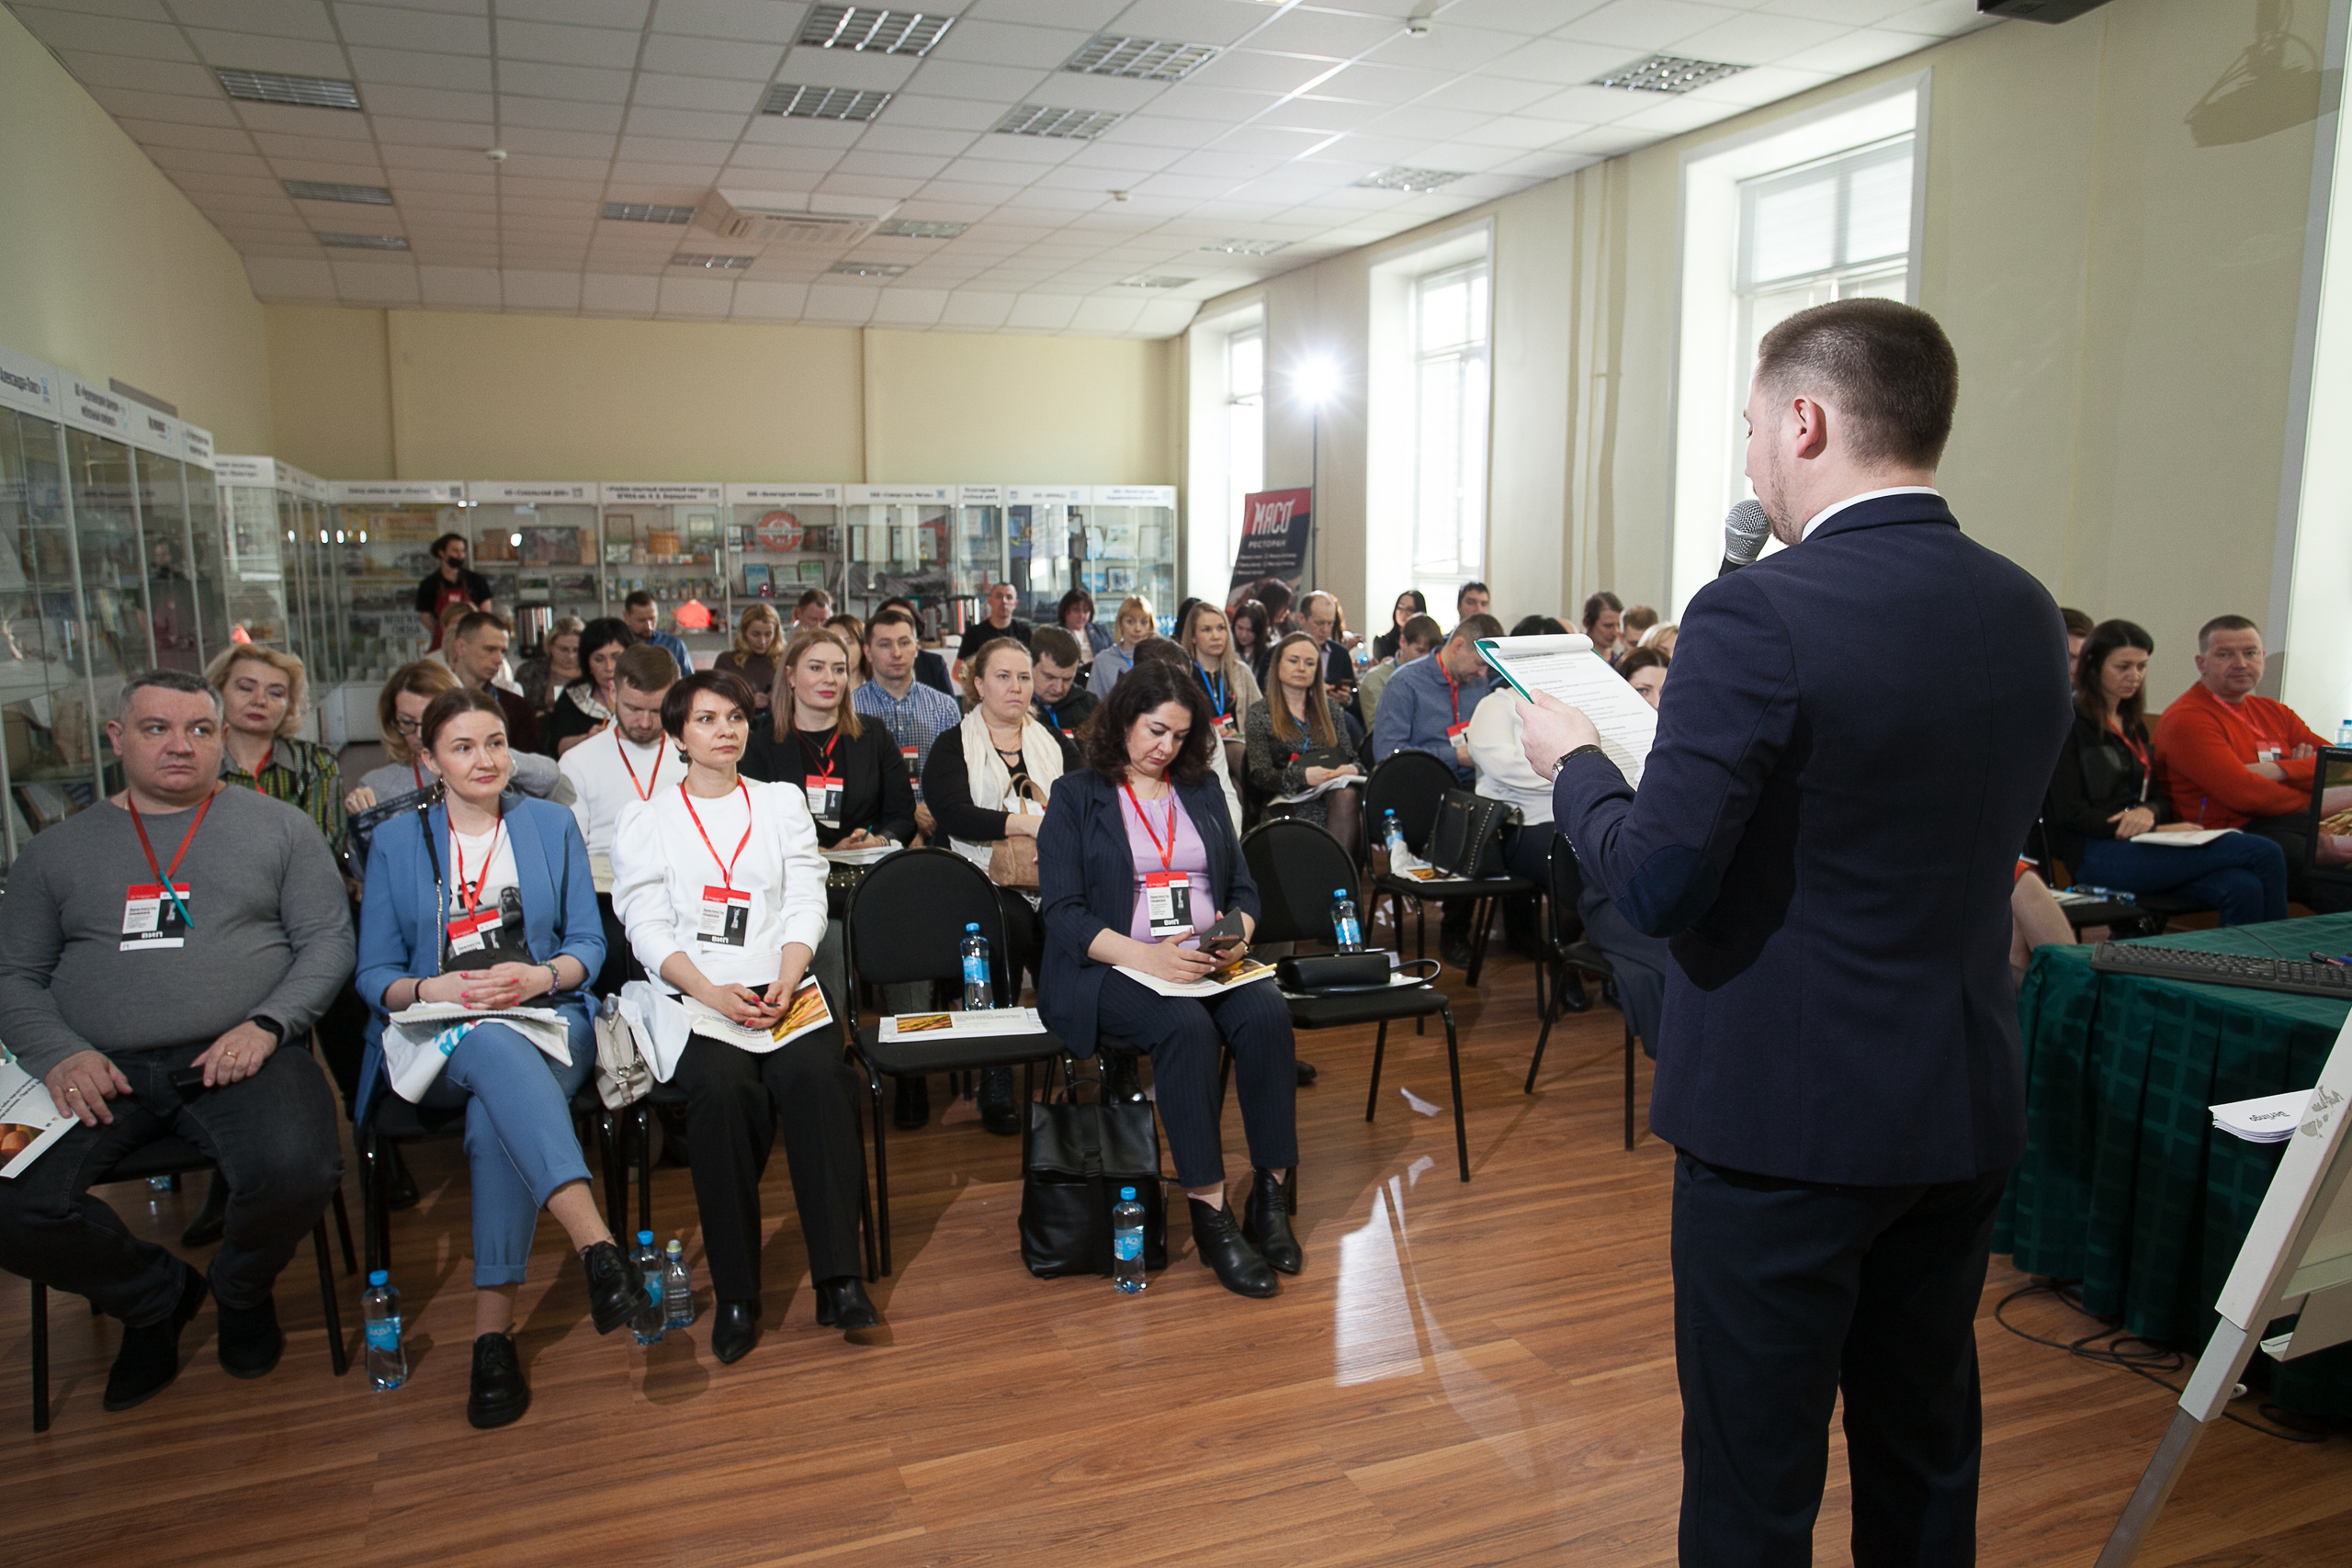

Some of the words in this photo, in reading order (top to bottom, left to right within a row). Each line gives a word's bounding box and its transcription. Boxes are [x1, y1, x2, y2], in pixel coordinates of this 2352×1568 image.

[1248, 539, 1286, 549] РЕСТОРАН
[141, 931, 164, 939] ВИП
[711, 935, 729, 943] ВИП
[2249, 1111, 2290, 1122] Berlingo
